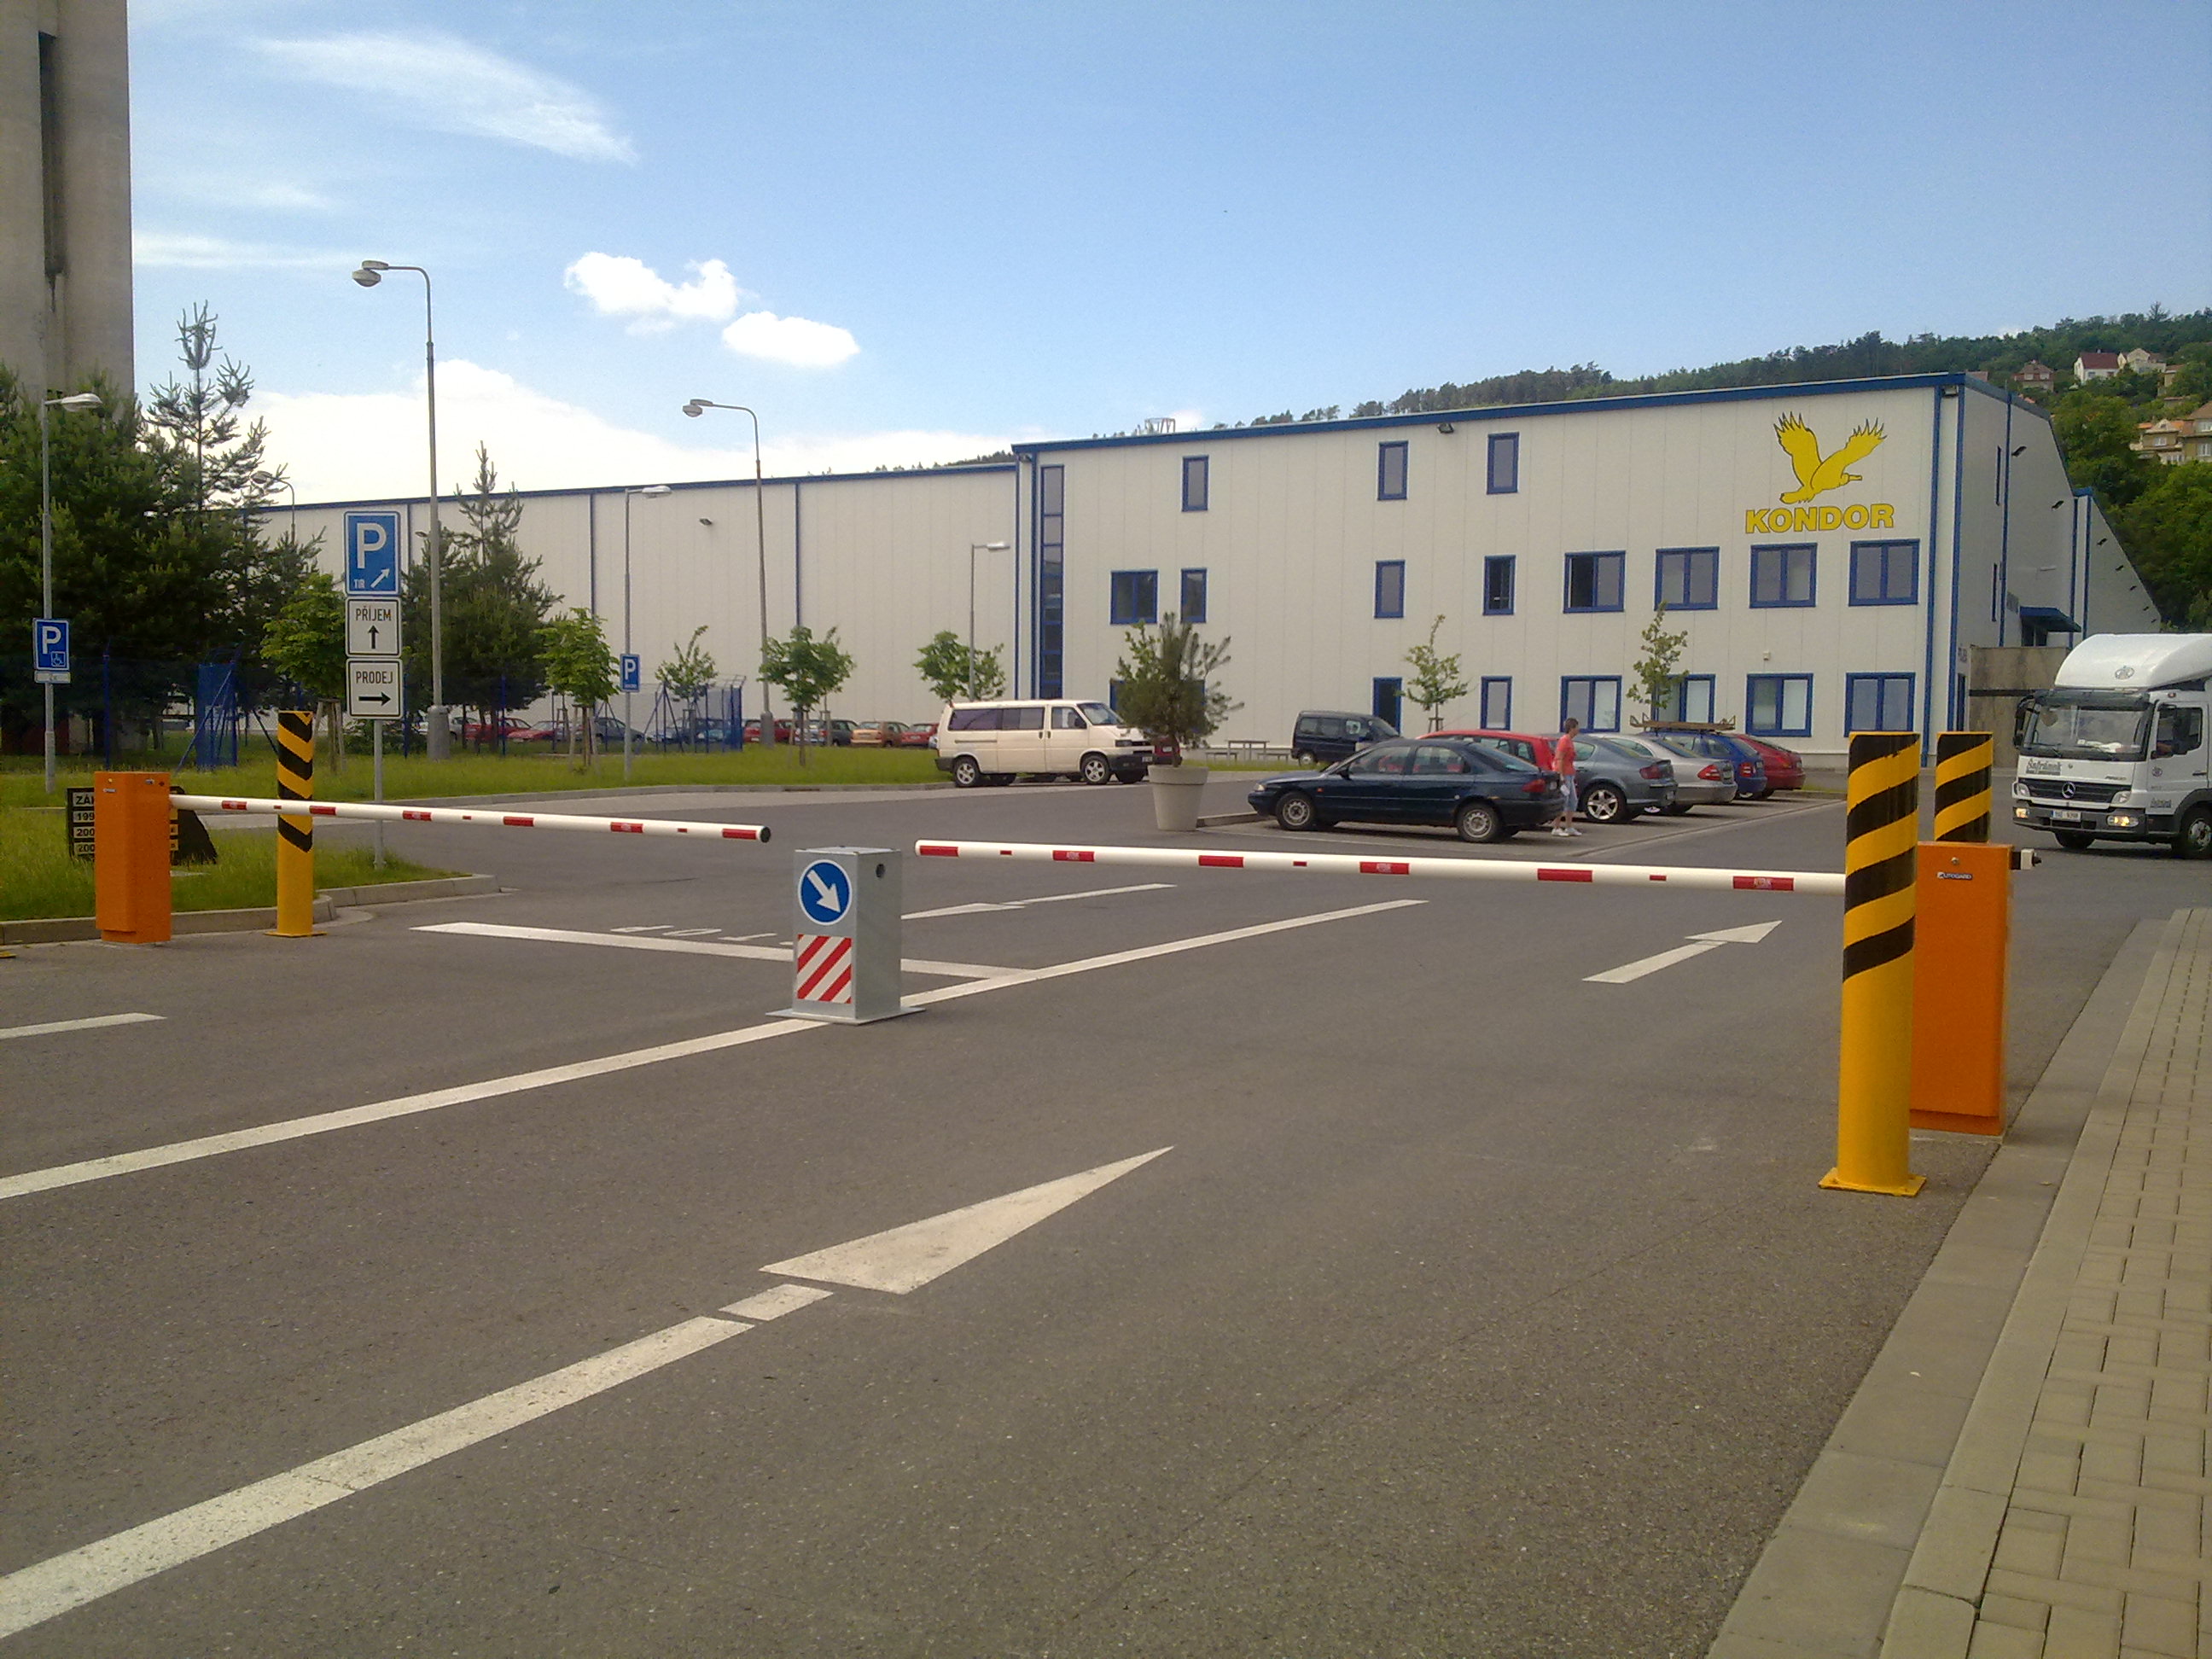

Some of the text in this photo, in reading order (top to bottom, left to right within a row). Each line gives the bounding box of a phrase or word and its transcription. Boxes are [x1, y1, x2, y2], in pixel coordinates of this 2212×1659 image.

[1744, 503, 1895, 534] KONDOR
[356, 522, 387, 569] P
[355, 605, 392, 621] PŘÍJEM
[41, 626, 62, 655] P
[356, 670, 393, 684] PRODEJ
[624, 658, 637, 680] P
